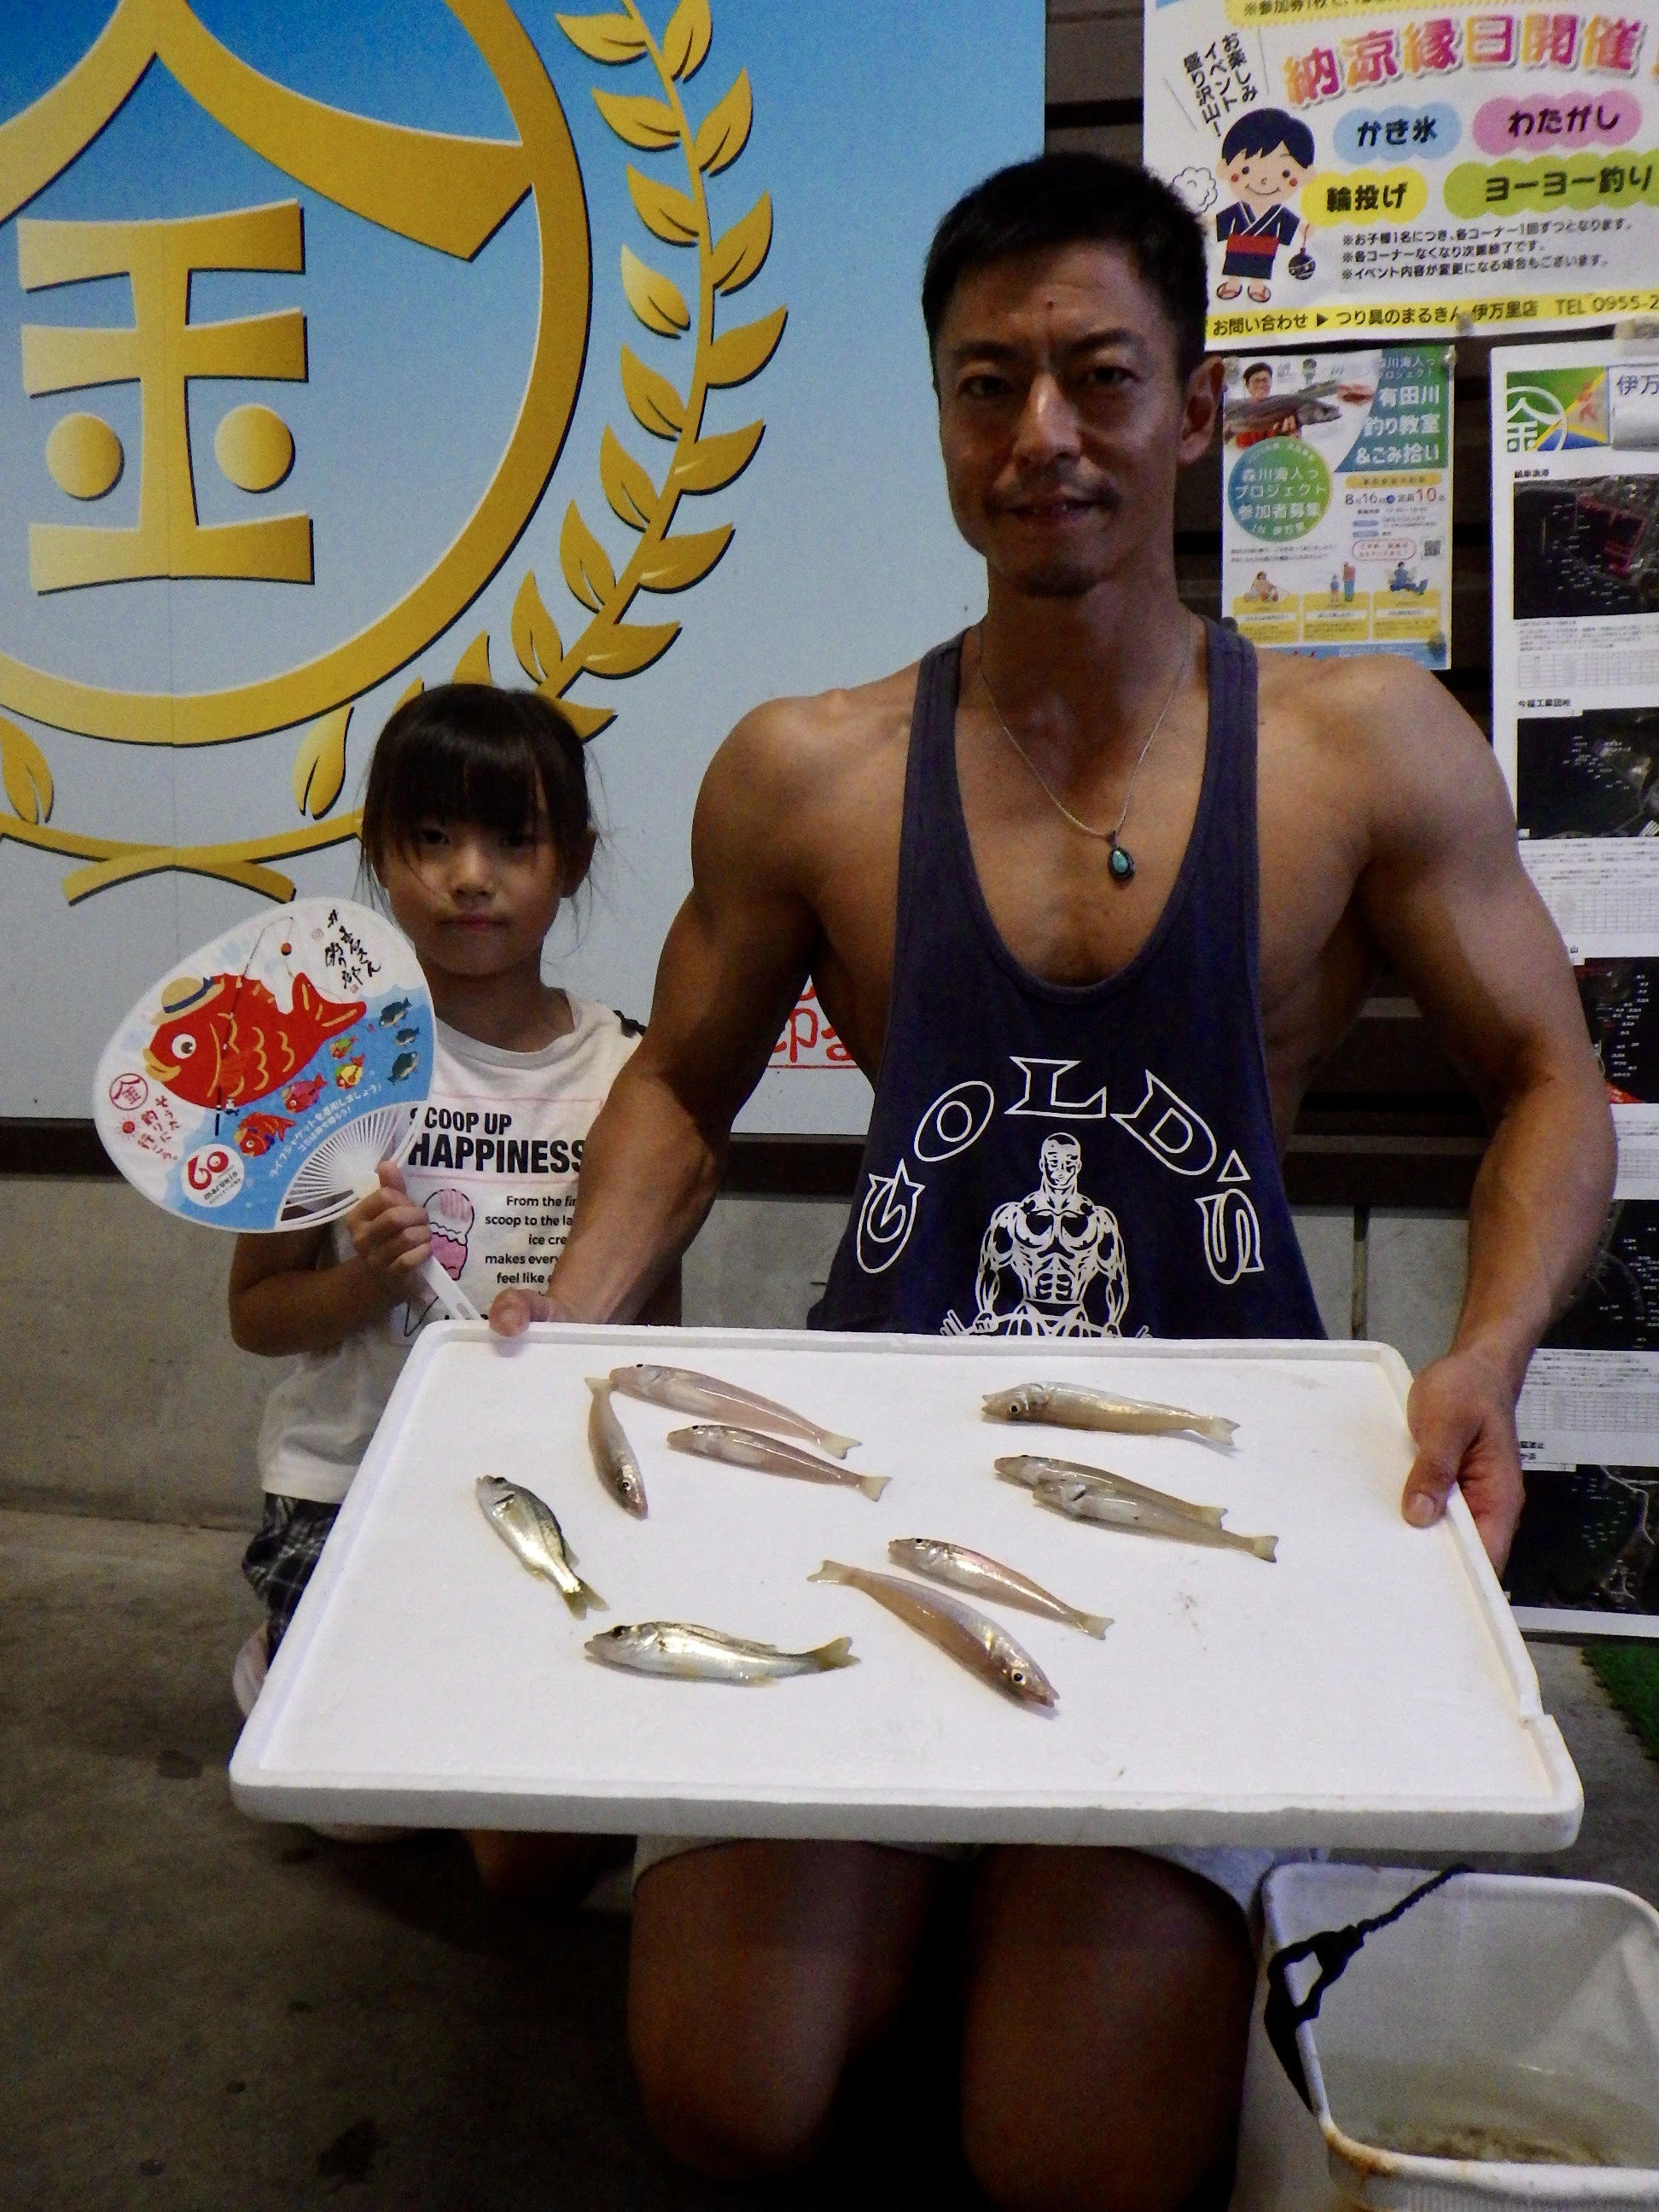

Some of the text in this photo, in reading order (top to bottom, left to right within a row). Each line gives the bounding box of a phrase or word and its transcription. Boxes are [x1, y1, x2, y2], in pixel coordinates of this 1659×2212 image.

[1283, 13, 1659, 104] 納涼縁日開催
[1204, 41, 1238, 114] イベント
[1357, 115, 1438, 147] かき氷
[1507, 104, 1621, 137] わたがし
[1326, 181, 1408, 212] 輪投げ
[1485, 165, 1653, 202] ヨーヨー釣り
[1213, 313, 1308, 335] お問い合わせ
[1471, 300, 1539, 321] 伊万里店
[1556, 299, 1586, 315] TEL
[1379, 384, 1441, 407] 有田川
[484, 1112, 512, 1136] UP
[506, 1196, 538, 1207] From
[542, 1196, 562, 1207] the
[485, 1215, 521, 1228] scoop
[524, 1215, 538, 1225] to
[540, 1215, 560, 1226] the
[528, 1234, 545, 1245] ice
[485, 1253, 526, 1264] makes
[497, 1272, 520, 1284] feel
[522, 1272, 544, 1284] like
